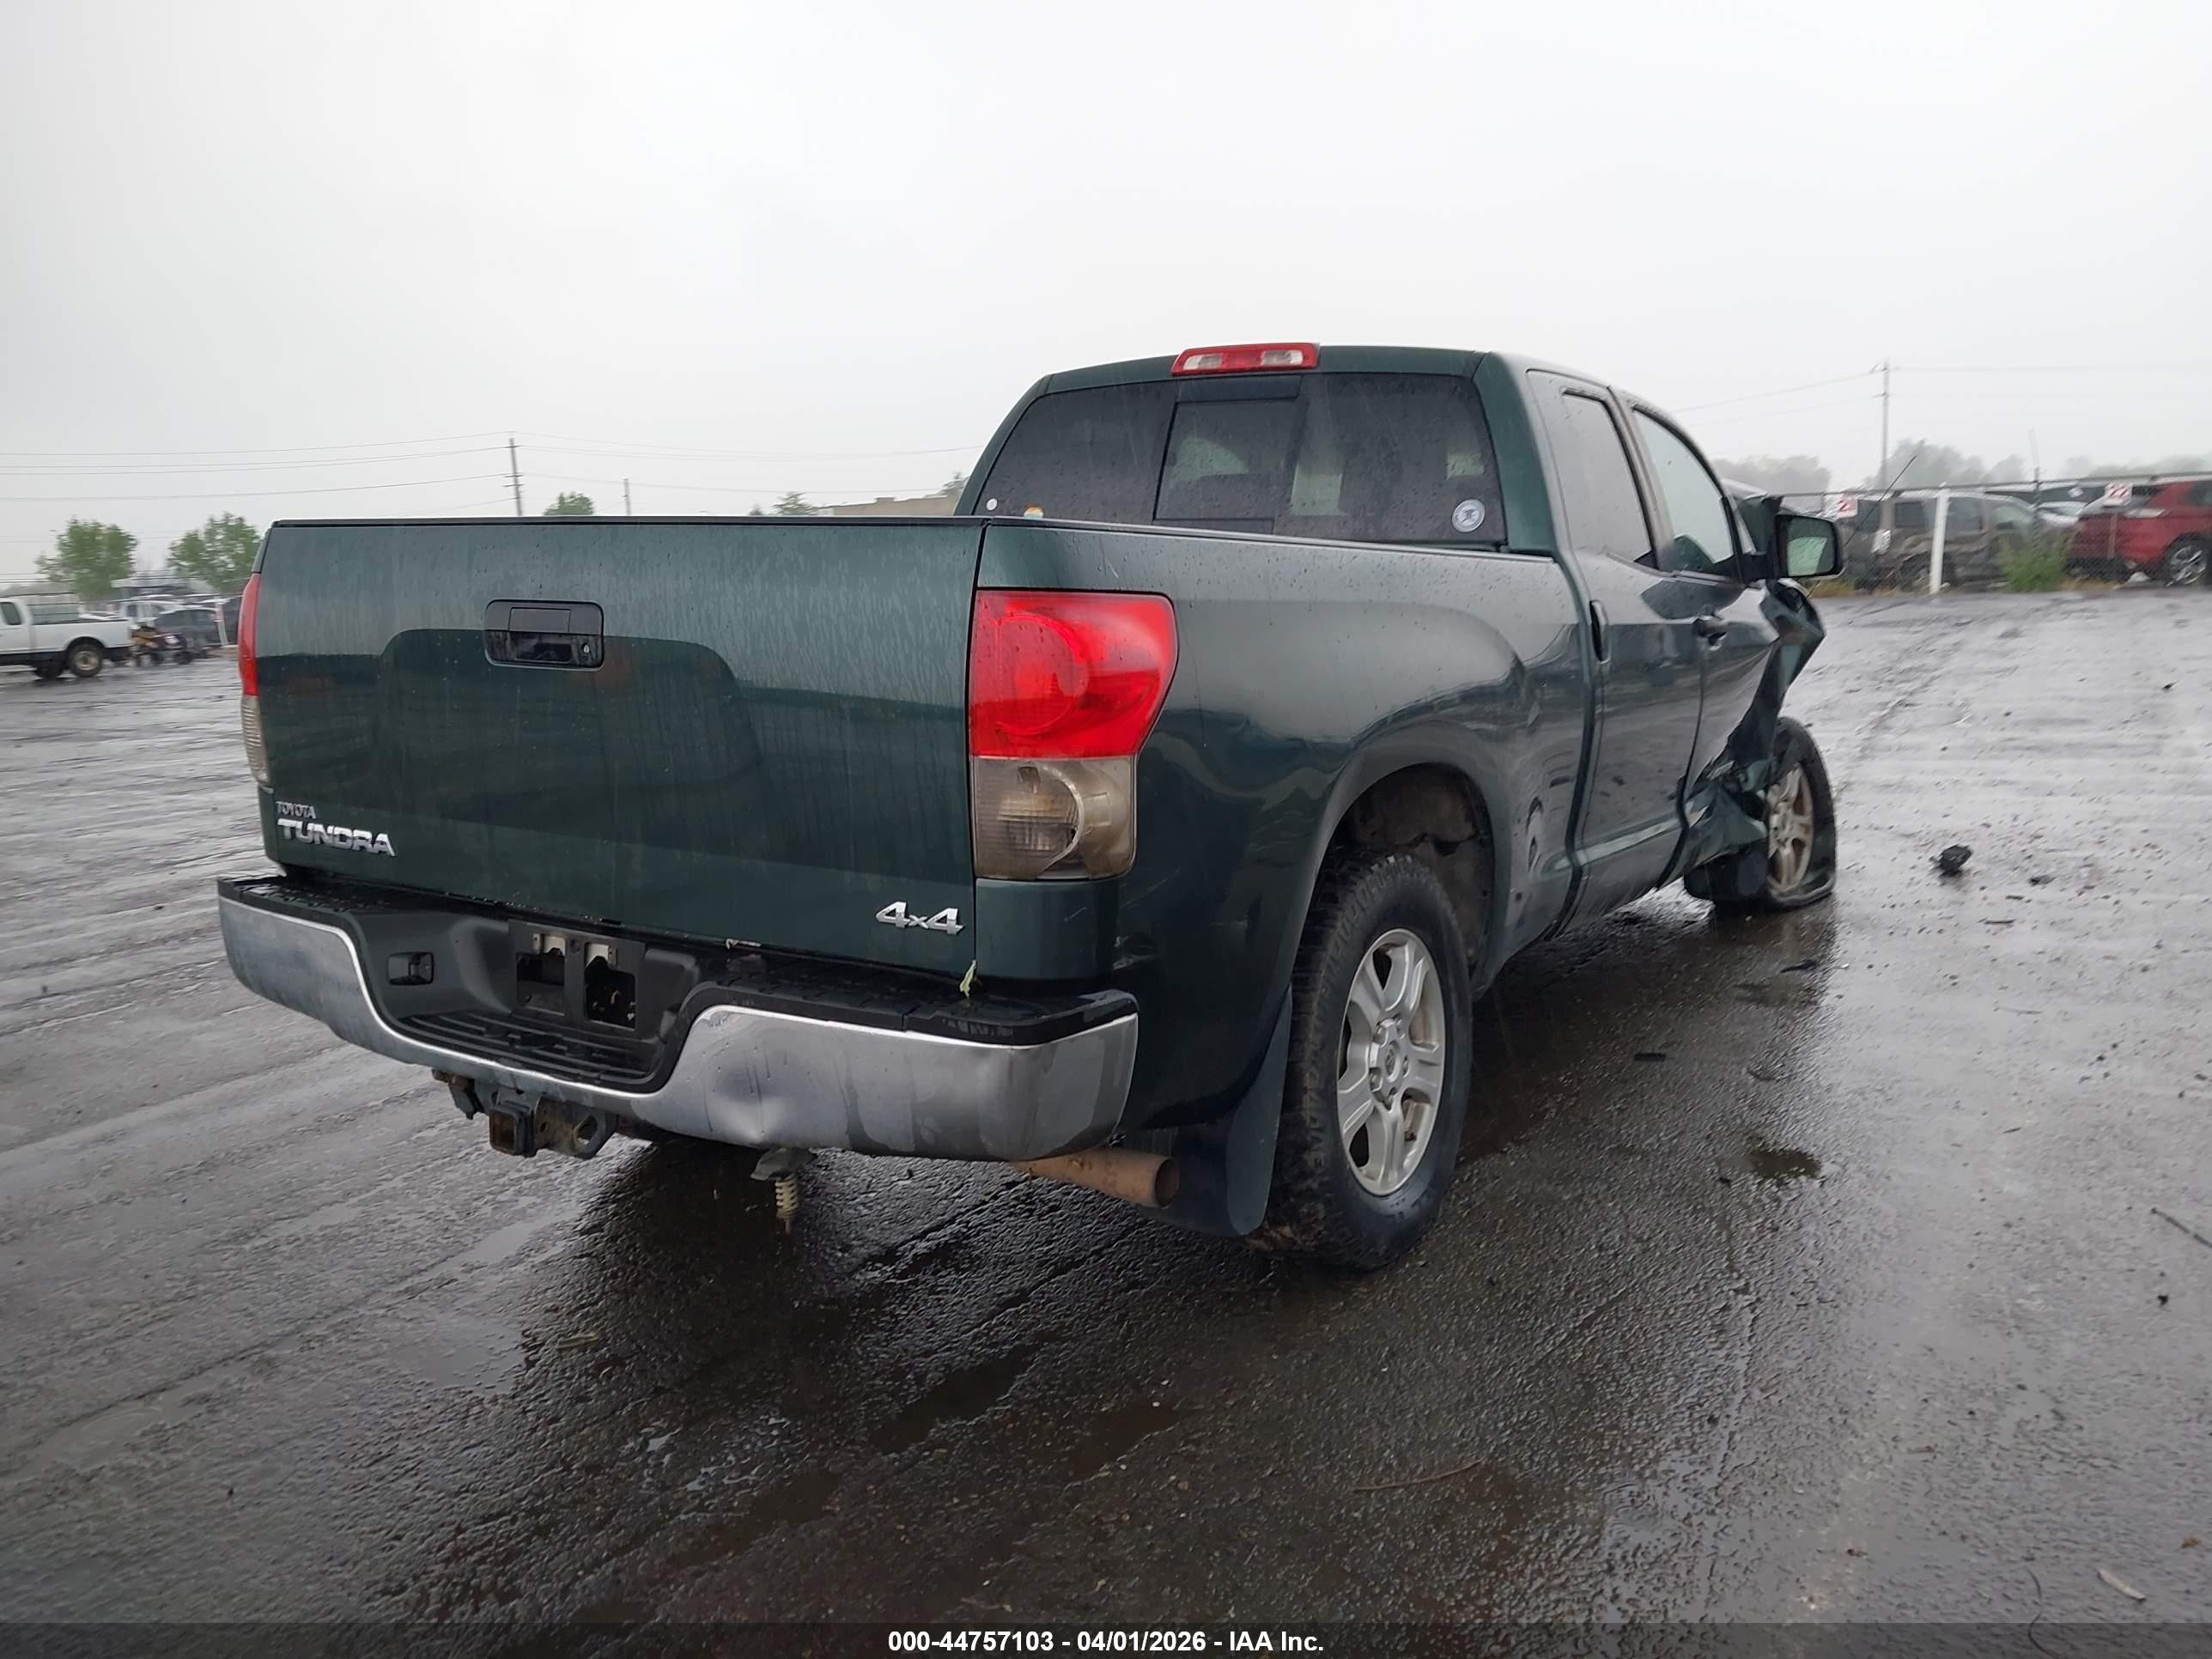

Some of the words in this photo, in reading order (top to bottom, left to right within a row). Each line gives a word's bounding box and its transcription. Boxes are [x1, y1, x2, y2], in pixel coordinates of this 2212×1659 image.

[275, 800, 317, 819] TOYOTA
[276, 817, 396, 857] TUNDRA
[875, 901, 964, 935] 4x4
